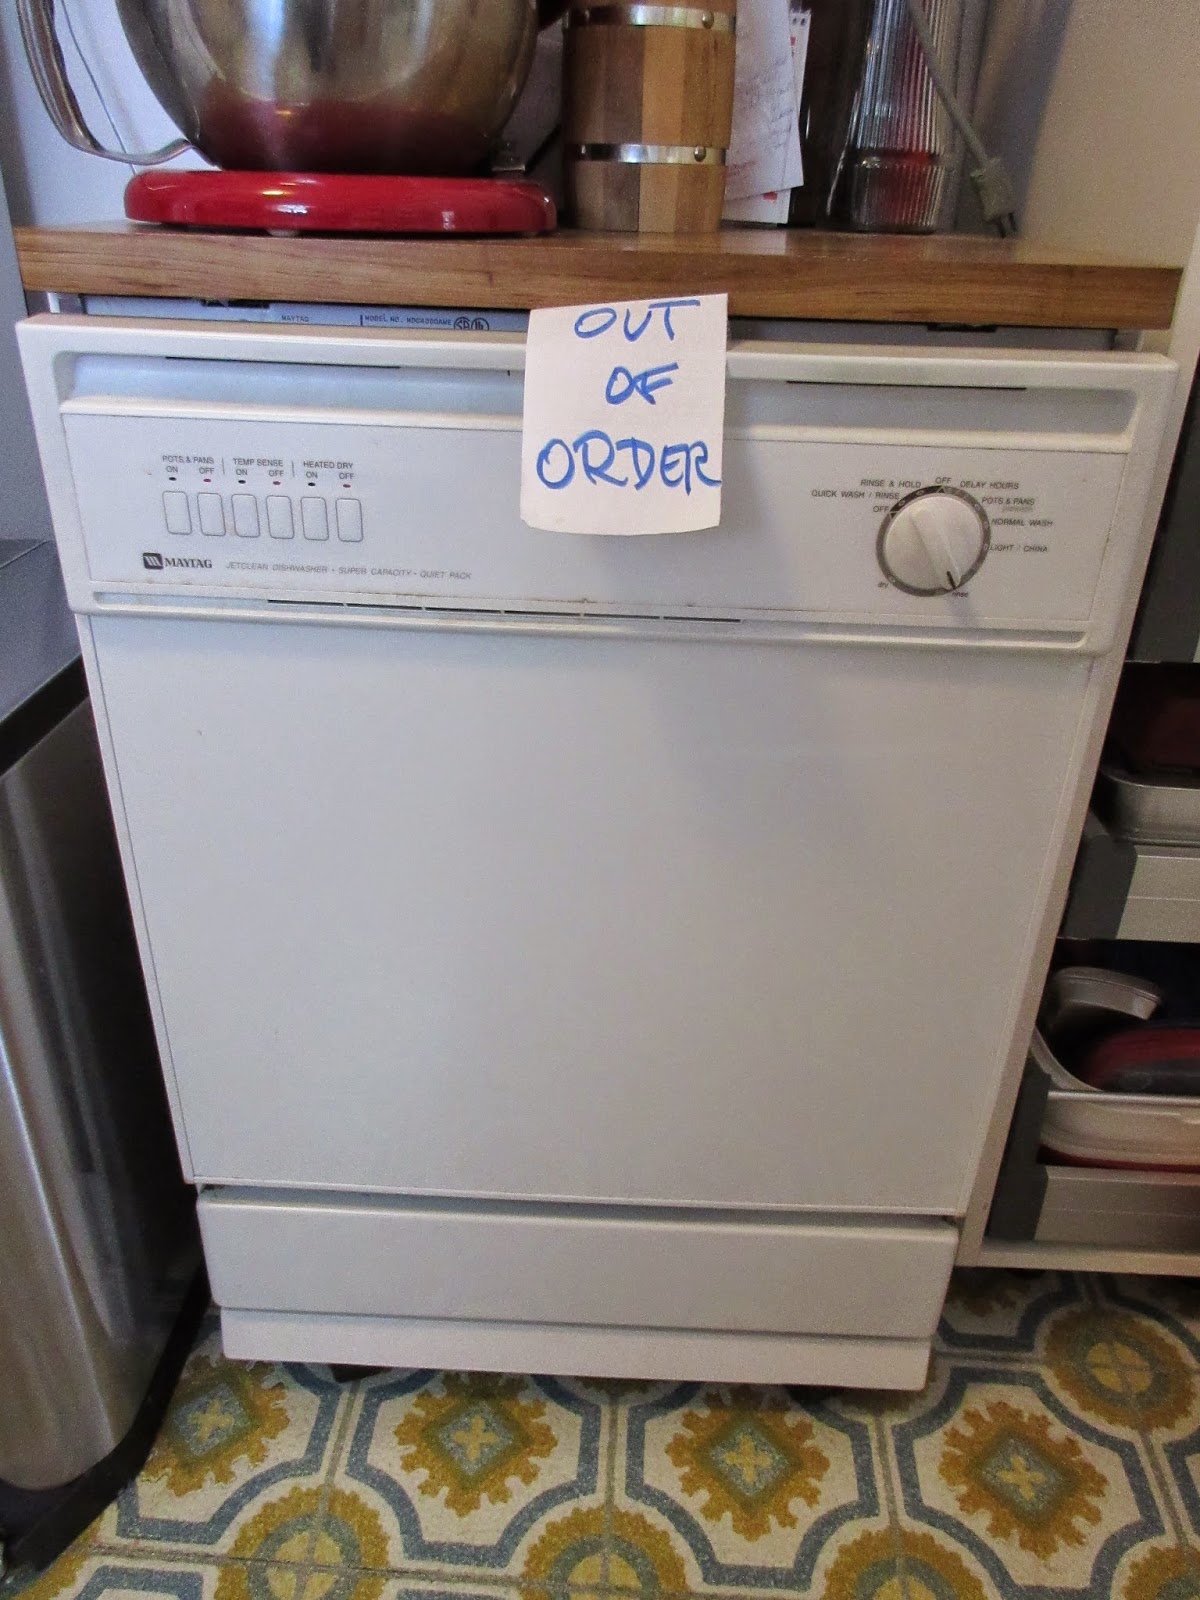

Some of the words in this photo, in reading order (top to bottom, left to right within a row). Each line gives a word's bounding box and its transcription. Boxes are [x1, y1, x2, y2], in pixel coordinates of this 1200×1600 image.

[281, 315, 309, 323] MAYTAG
[364, 314, 386, 322] MODEL
[574, 299, 700, 342] OUT
[605, 362, 679, 405] OF
[162, 455, 184, 463] POTS
[193, 456, 214, 464] PANS
[233, 458, 254, 466] TEMP
[257, 458, 284, 467] SENSE
[536, 429, 722, 496] ORDER
[166, 465, 178, 473] ON
[199, 467, 215, 475] OFF
[303, 461, 334, 469] HEATED
[337, 462, 354, 470] DRY
[236, 468, 248, 476] ON
[268, 469, 284, 478] OFF
[305, 471, 318, 479] ON
[339, 472, 354, 480] OFF
[860, 478, 885, 487] RINSE
[898, 480, 922, 488] HOLD
[935, 476, 952, 484] OFF
[960, 480, 986, 489] DELAY
[990, 481, 1019, 490] HOURS
[811, 489, 837, 498] QUICK
[841, 490, 865, 499] WASH
[982, 497, 1003, 505] POTS
[1013, 497, 1036, 506] PANS
[873, 505, 890, 513] OFF
[991, 518, 1025, 526] NORMAL
[1029, 519, 1054, 527] WASH
[1023, 545, 1048, 553] CHINA
[164, 557, 213, 569] MAYTAG
[226, 561, 269, 570] JETCLEAN
[338, 566, 367, 575] SUPER
[370, 567, 412, 577] CAPACITY
[419, 569, 446, 579] QUIET
[449, 571, 472, 580] PACK
